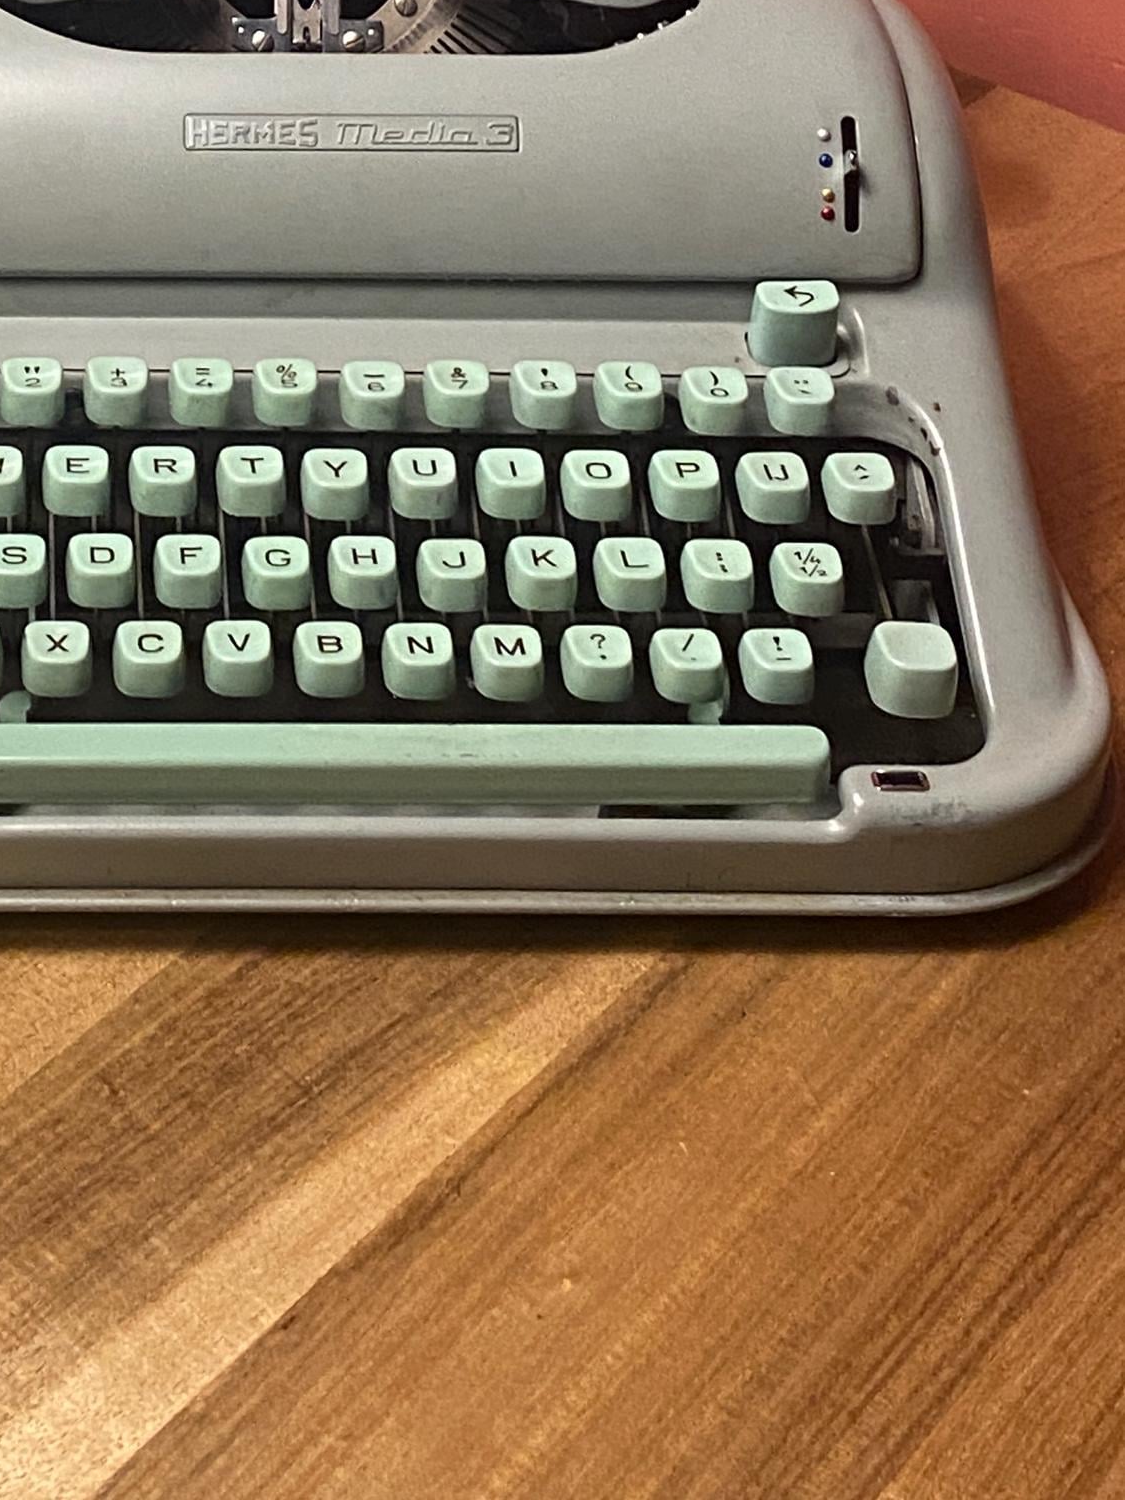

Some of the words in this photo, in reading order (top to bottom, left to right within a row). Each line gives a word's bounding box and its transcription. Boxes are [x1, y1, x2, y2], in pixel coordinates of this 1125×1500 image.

[186, 118, 319, 148] HERMES
[336, 120, 478, 146] Media
[485, 123, 515, 146] 3
[450, 367, 466, 378] &
[25, 378, 42, 388] 2
[110, 377, 127, 388] 3
[451, 379, 469, 389] 7
[540, 381, 559, 390] 8
[65, 457, 90, 474] E
[153, 458, 178, 474] R
[240, 457, 265, 474] T
[323, 460, 348, 478] Y
[412, 459, 438, 477] U
[509, 460, 518, 478] I
[585, 462, 612, 480] O
[675, 461, 701, 479] P
[1, 546, 28, 565] S
[89, 546, 115, 564] D
[179, 546, 203, 565] F
[264, 548, 292, 568] G
[351, 547, 380, 566] H
[442, 551, 466, 569] J
[530, 548, 557, 568] K
[620, 549, 649, 569] L
[45, 634, 69, 653] X
[137, 633, 165, 653] C
[227, 633, 251, 652] V
[316, 634, 344, 654] B
[406, 635, 435, 655] N
[493, 636, 527, 656] M
